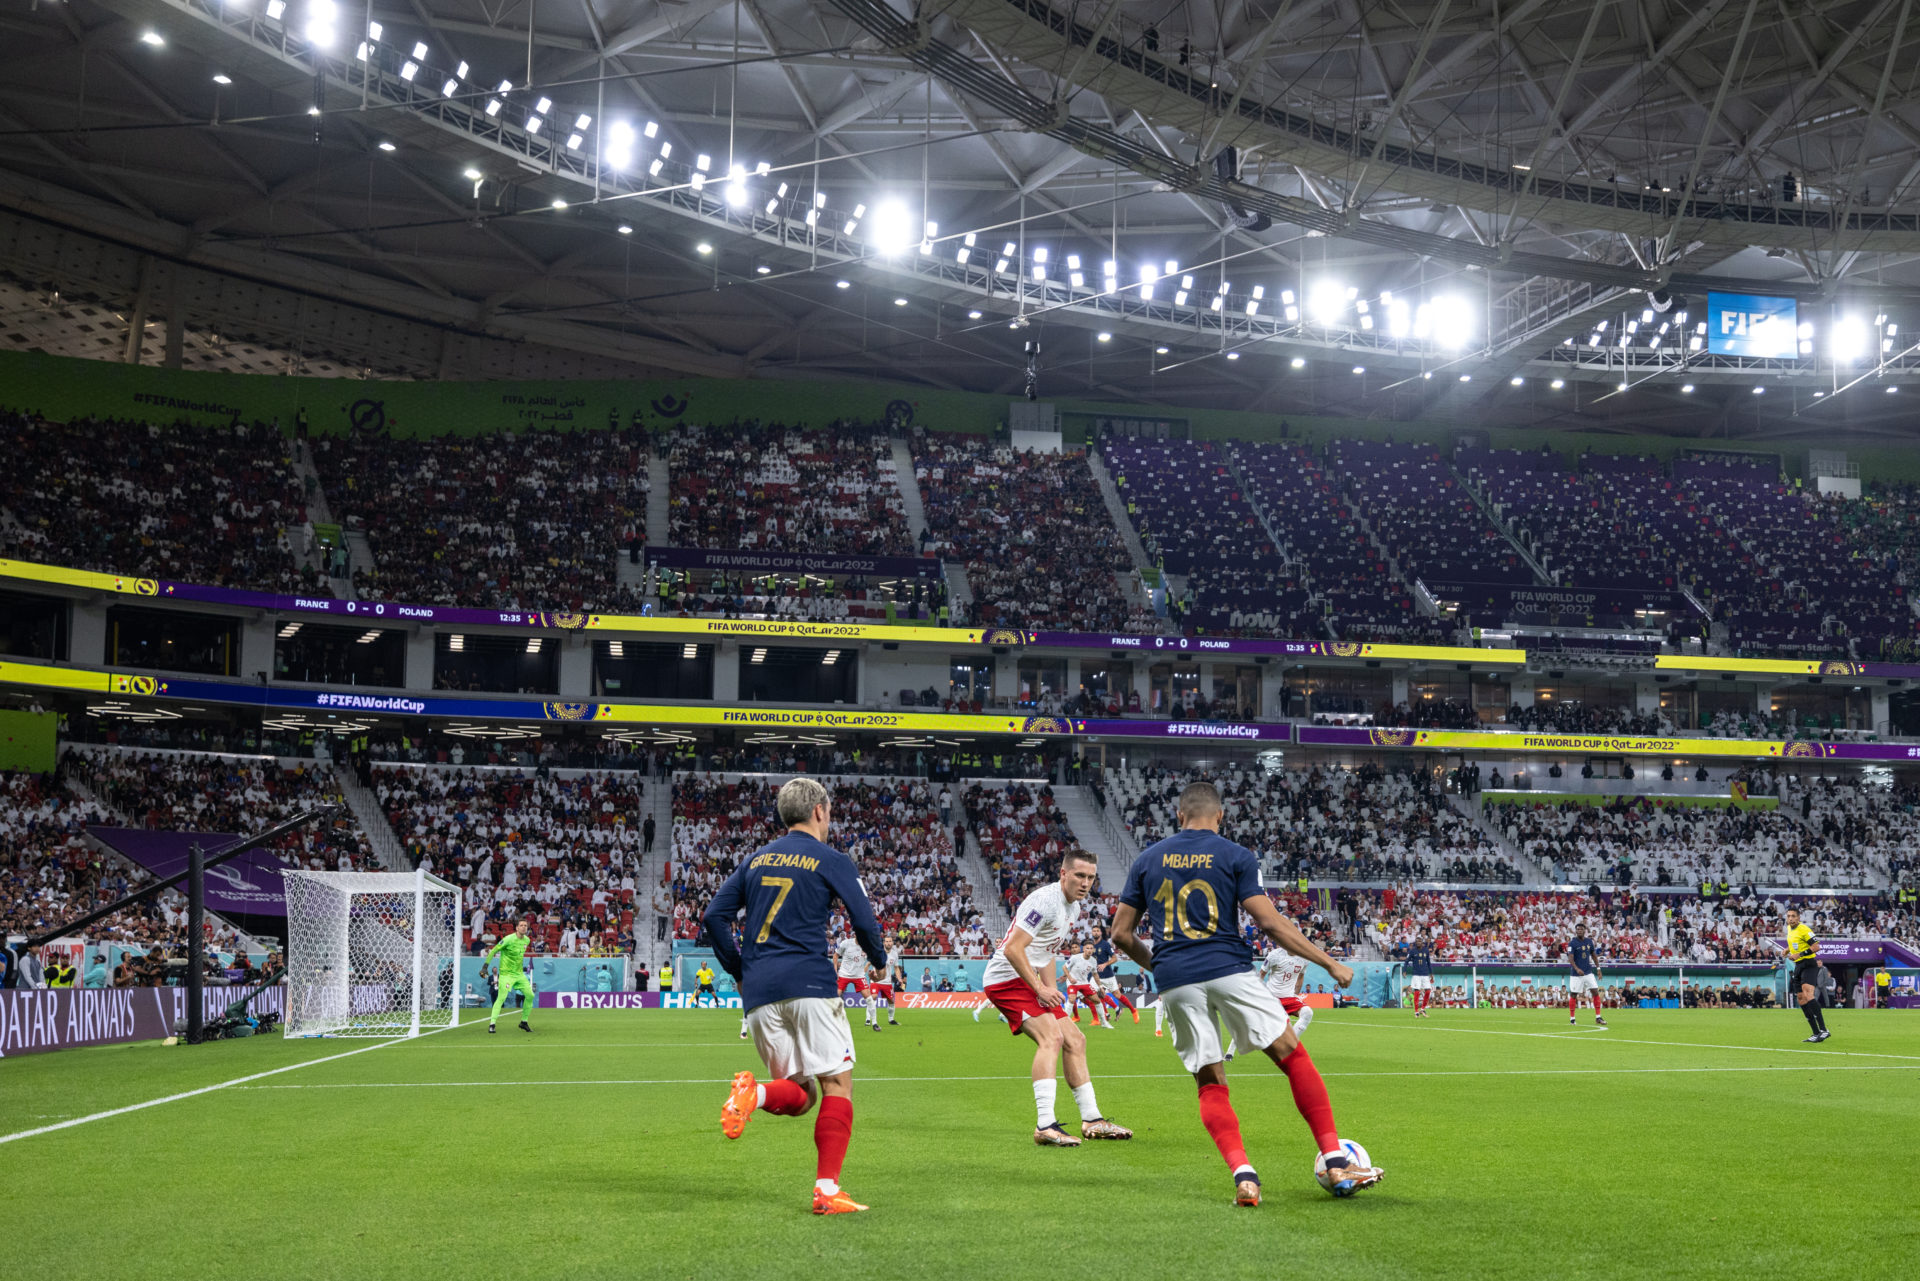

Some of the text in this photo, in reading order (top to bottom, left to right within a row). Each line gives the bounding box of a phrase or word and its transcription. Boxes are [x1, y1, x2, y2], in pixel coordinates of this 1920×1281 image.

[1721, 311, 1780, 337] FIF
[133, 393, 242, 417] #FIFAWorldCup
[502, 395, 525, 405] FIFA
[705, 554, 730, 565] FIFA
[731, 555, 770, 566] WORLD
[772, 557, 794, 568] CUP
[1511, 591, 1596, 604] FIFA WORLD CUP
[295, 599, 330, 609] FRANCE
[347, 601, 356, 612] 0
[375, 603, 385, 615] 0
[399, 607, 434, 617] POLAND
[499, 613, 521, 623] 12:35
[1230, 612, 1281, 629] now
[707, 622, 729, 631] FIFA
[731, 623, 766, 632] WORLD
[768, 624, 787, 632] CUP
[1112, 637, 1141, 646] FRANCE
[1155, 637, 1164, 647] 0
[1180, 638, 1188, 648] 0
[1200, 640, 1230, 649] POLAND
[1286, 644, 1305, 652] 12:35
[1741, 641, 1750, 649] Al
[1807, 643, 1844, 652] Stadim
[317, 693, 425, 714] #FIFAWorldCup
[723, 711, 748, 721] FIFA
[749, 712, 790, 723] WORLD
[792, 713, 813, 723] CUP
[1167, 723, 1259, 739] #FIFAWorldCup
[1524, 737, 1545, 746] FIFA
[1546, 738, 1581, 748] WORLD
[1583, 739, 1601, 748] CUP
[750, 853, 820, 872] GRIEZMANN
[1162, 853, 1214, 869] MBAPPE
[756, 876, 794, 943] 7
[1153, 877, 1219, 941] 10
[580, 994, 643, 1008] BYJU'S
[663, 993, 743, 1008] Hisen
[66, 988, 135, 1043] AIRWAYS
